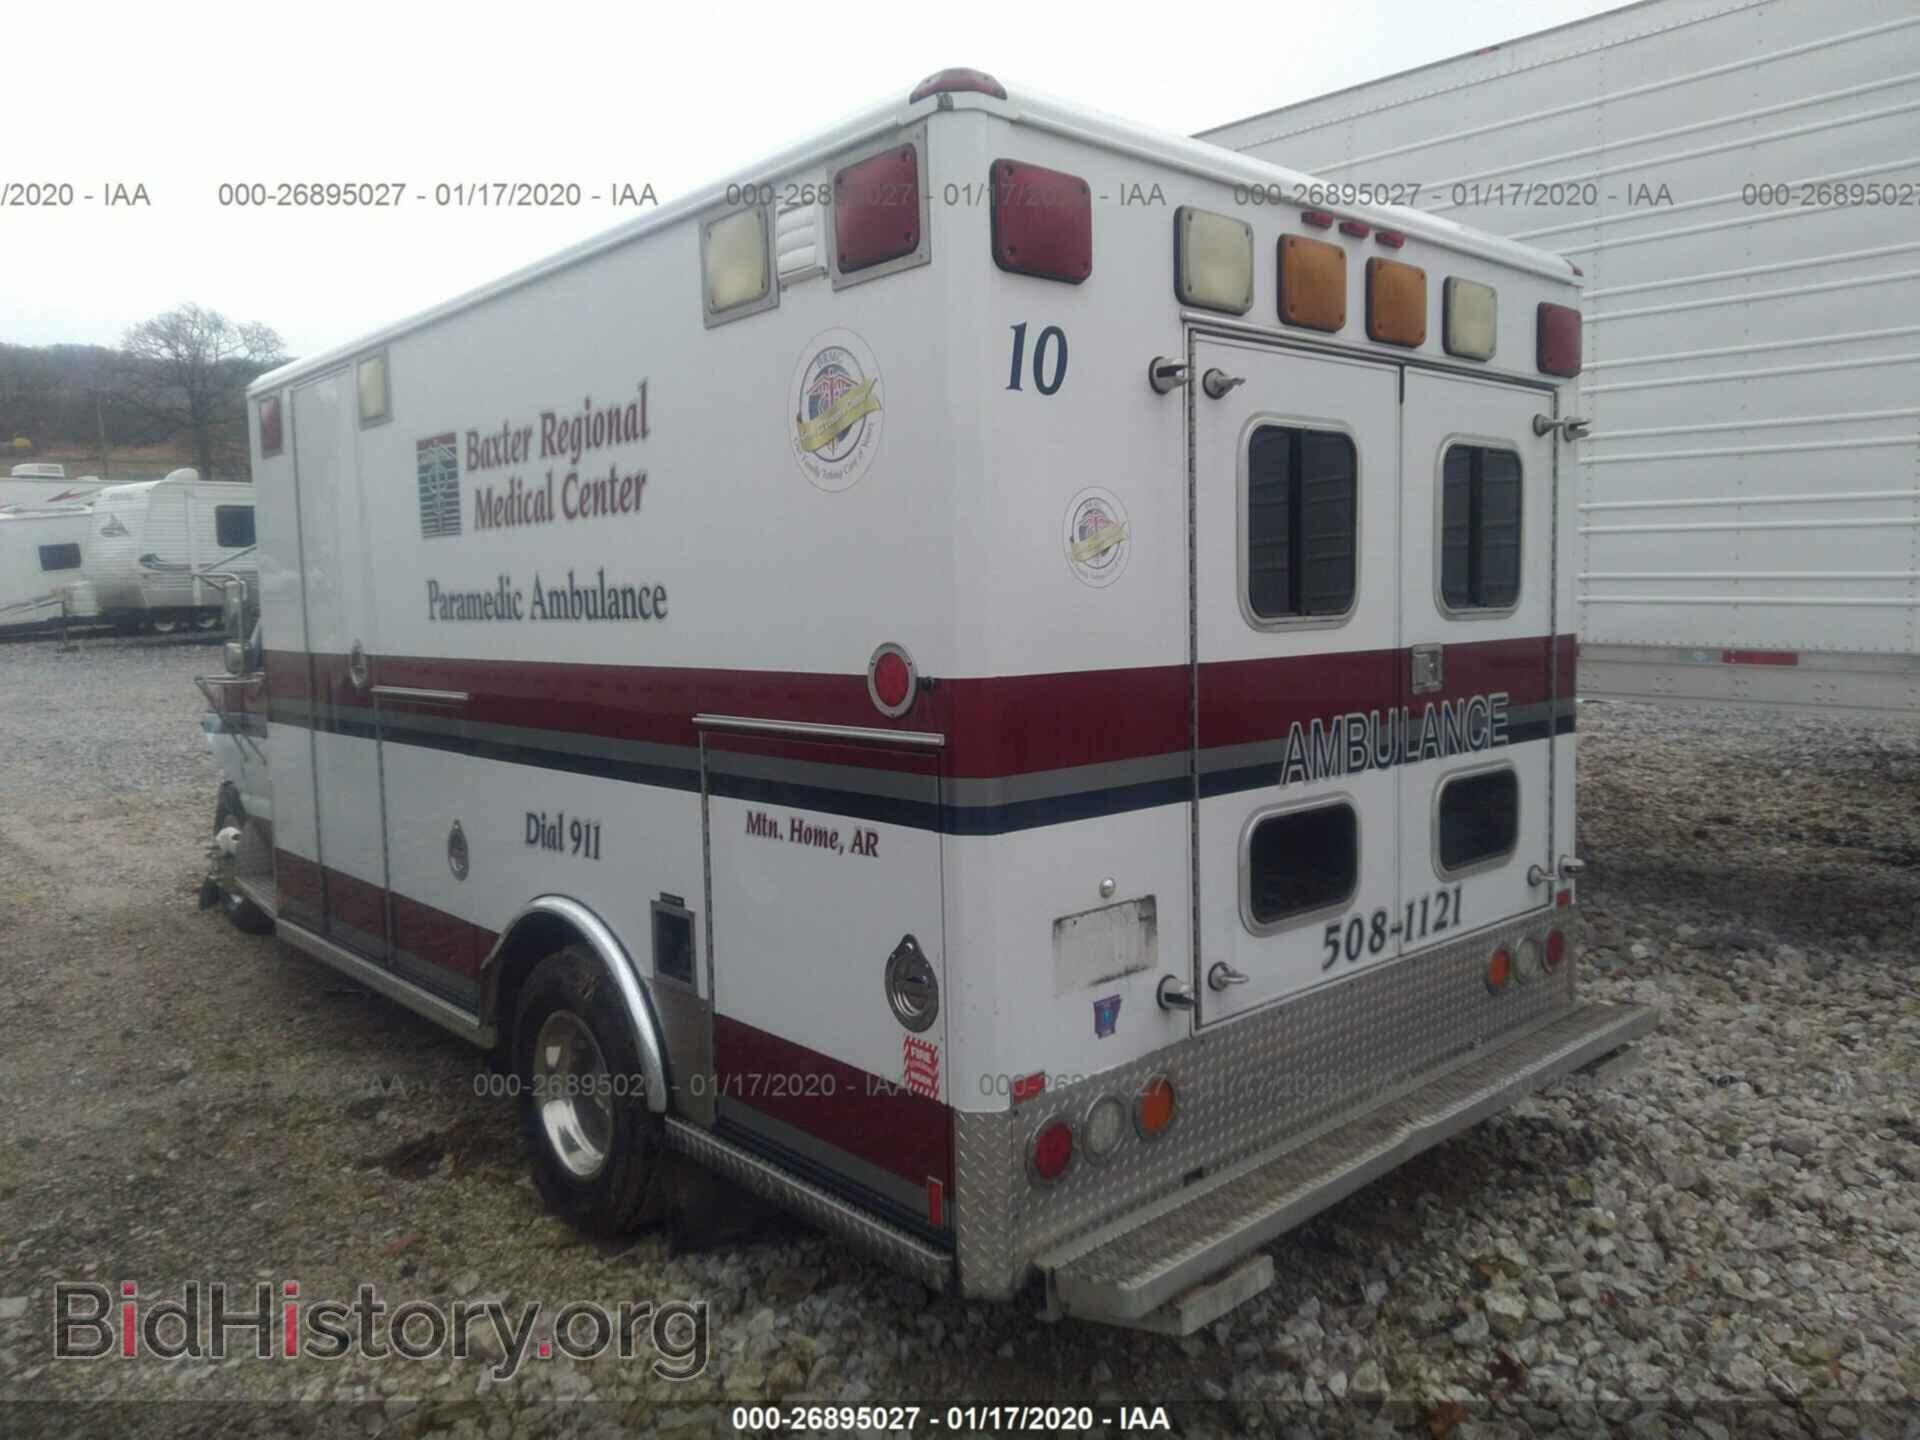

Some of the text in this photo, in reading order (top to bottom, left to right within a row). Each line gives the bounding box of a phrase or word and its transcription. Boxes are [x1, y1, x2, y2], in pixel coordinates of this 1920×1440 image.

[1005, 321, 1068, 395] 10
[466, 379, 650, 472] Baxter Regional
[474, 462, 648, 531] Medical Center
[426, 566, 669, 621] Paramedic Ambulance
[1280, 692, 1509, 789] AMBULANCE
[525, 811, 602, 860] Dial 911
[746, 810, 880, 858] Mtn. Home, AR
[1321, 885, 1463, 972] 508-1121
